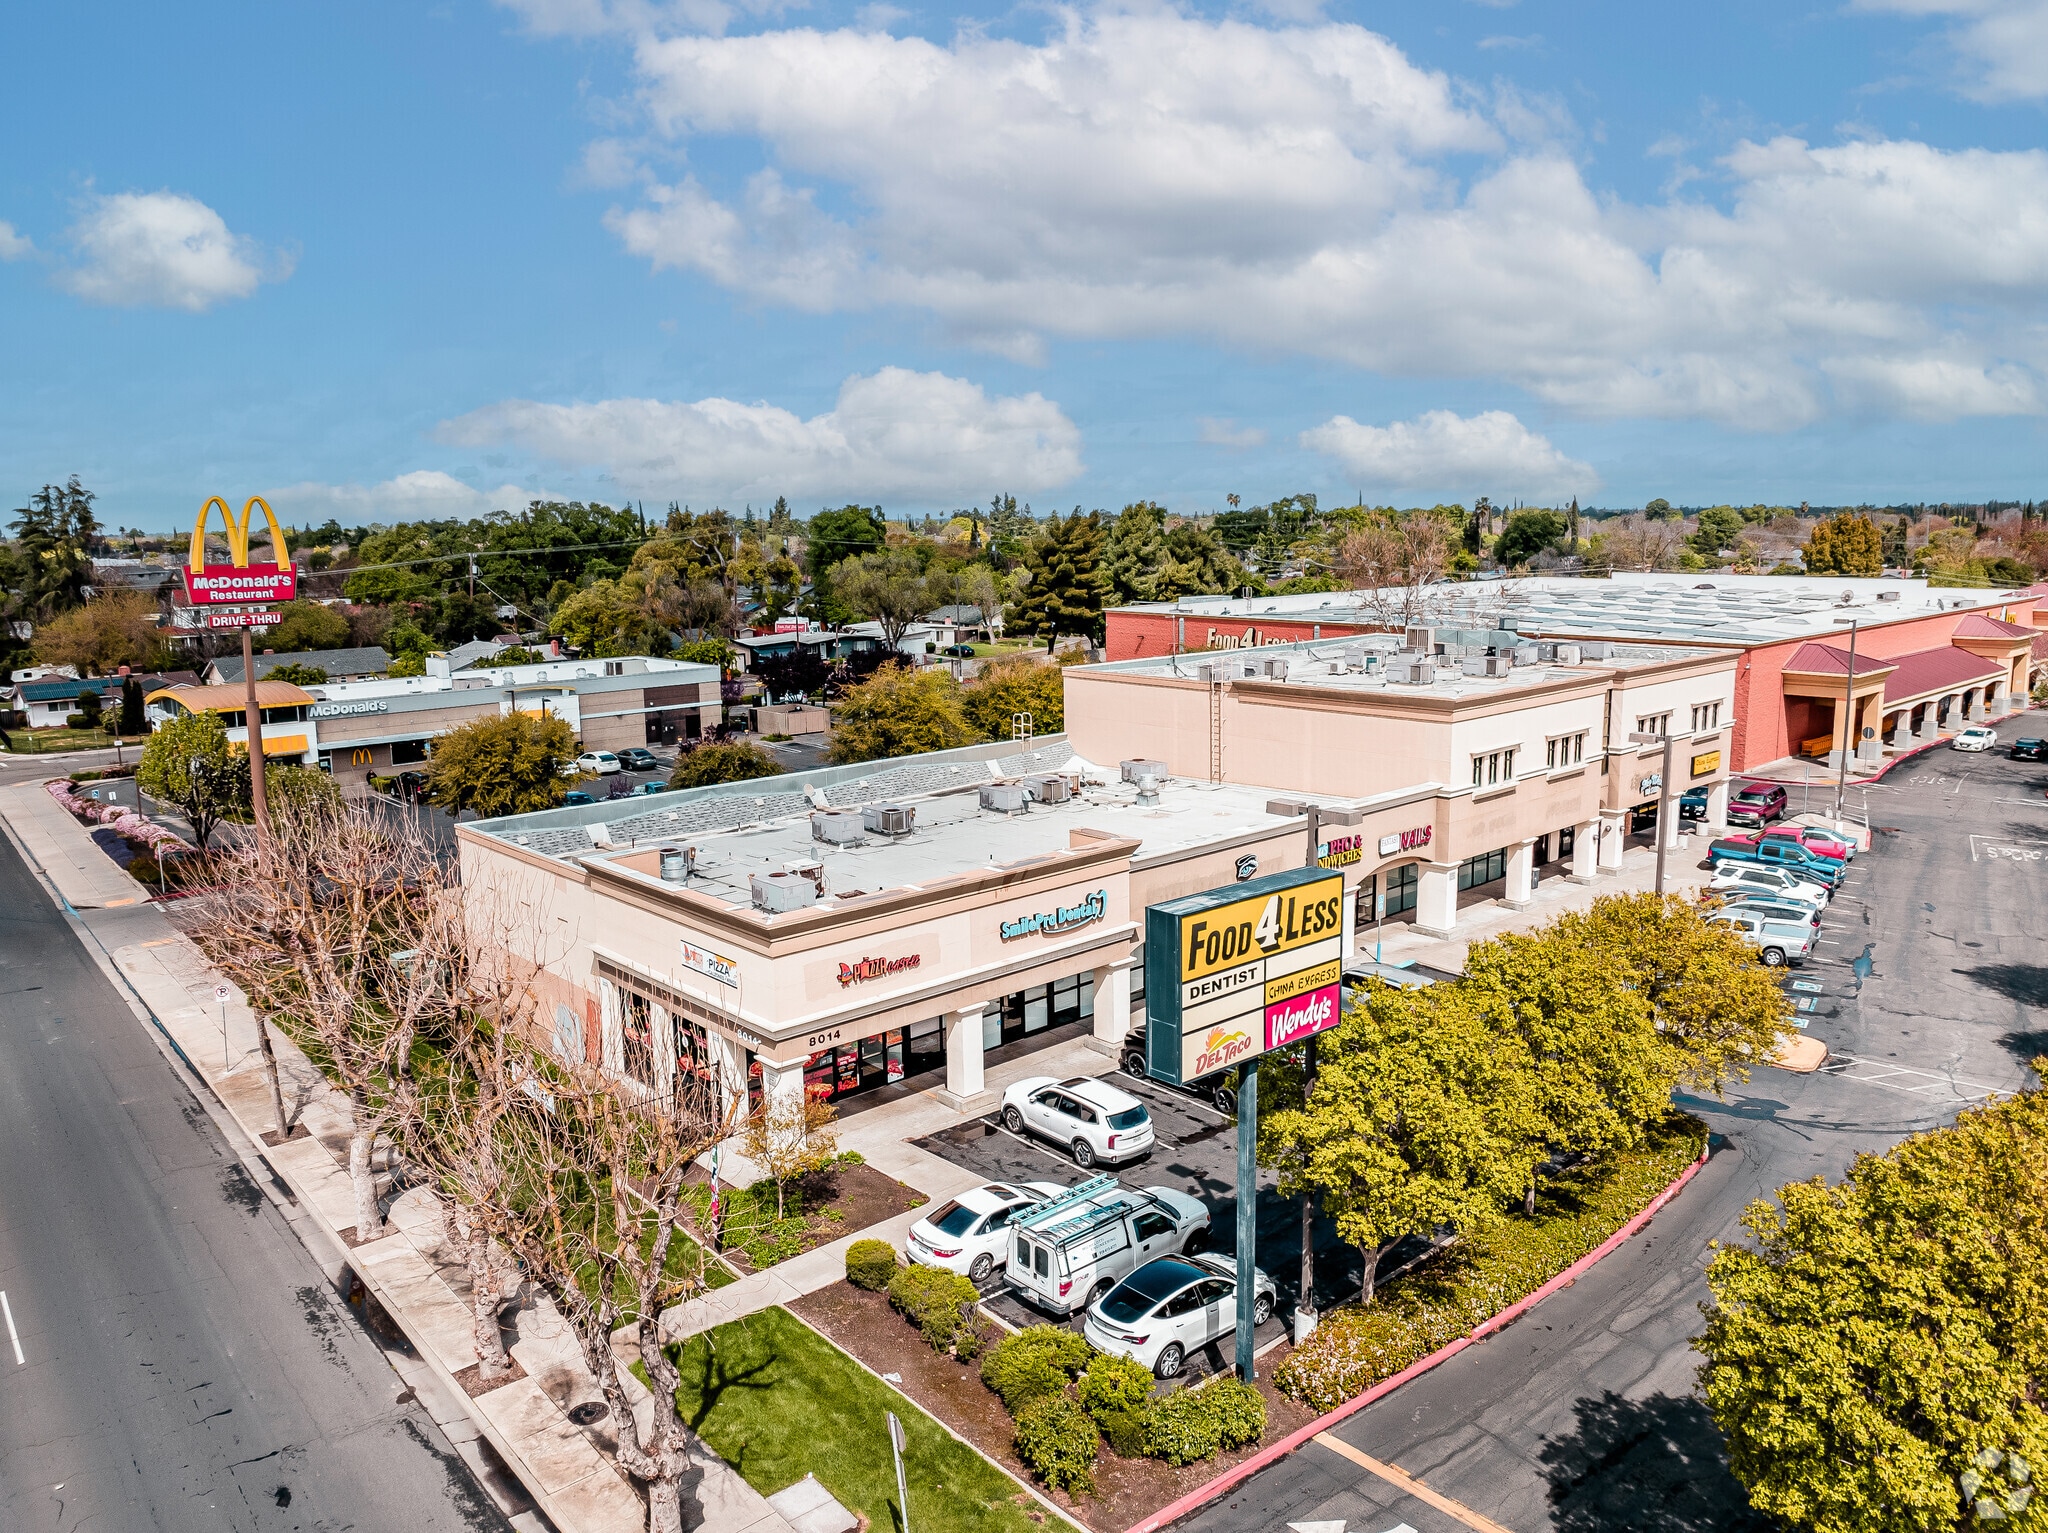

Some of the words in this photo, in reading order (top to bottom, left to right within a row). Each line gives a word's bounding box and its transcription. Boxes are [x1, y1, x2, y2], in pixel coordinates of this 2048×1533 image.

[193, 575, 292, 589] McDonald's
[210, 589, 274, 600] Restaurant
[212, 614, 281, 626] DRIVE-THRU
[1240, 627, 1255, 648] 4
[309, 700, 387, 717] McDonald's
[1329, 836, 1353, 856] PHO
[1400, 825, 1432, 849] NAILS
[1318, 848, 1362, 869] NDWICHES
[1001, 913, 1056, 939] SmilePro
[1057, 899, 1097, 924] Dental
[1188, 920, 1252, 971] FOOD
[1254, 895, 1283, 950] 4
[1285, 896, 1339, 942] LESS
[708, 958, 730, 977] PIZZA
[1190, 967, 1257, 1000] DENTIST
[1269, 981, 1294, 999] CHINA
[1298, 967, 1337, 990] EXPRESS
[1271, 994, 1332, 1047] Wendy's
[738, 1029, 761, 1046] 8014
[809, 1030, 841, 1047] 8014
[1195, 1050, 1222, 1075] DEL
[1223, 1036, 1251, 1063] TACO
